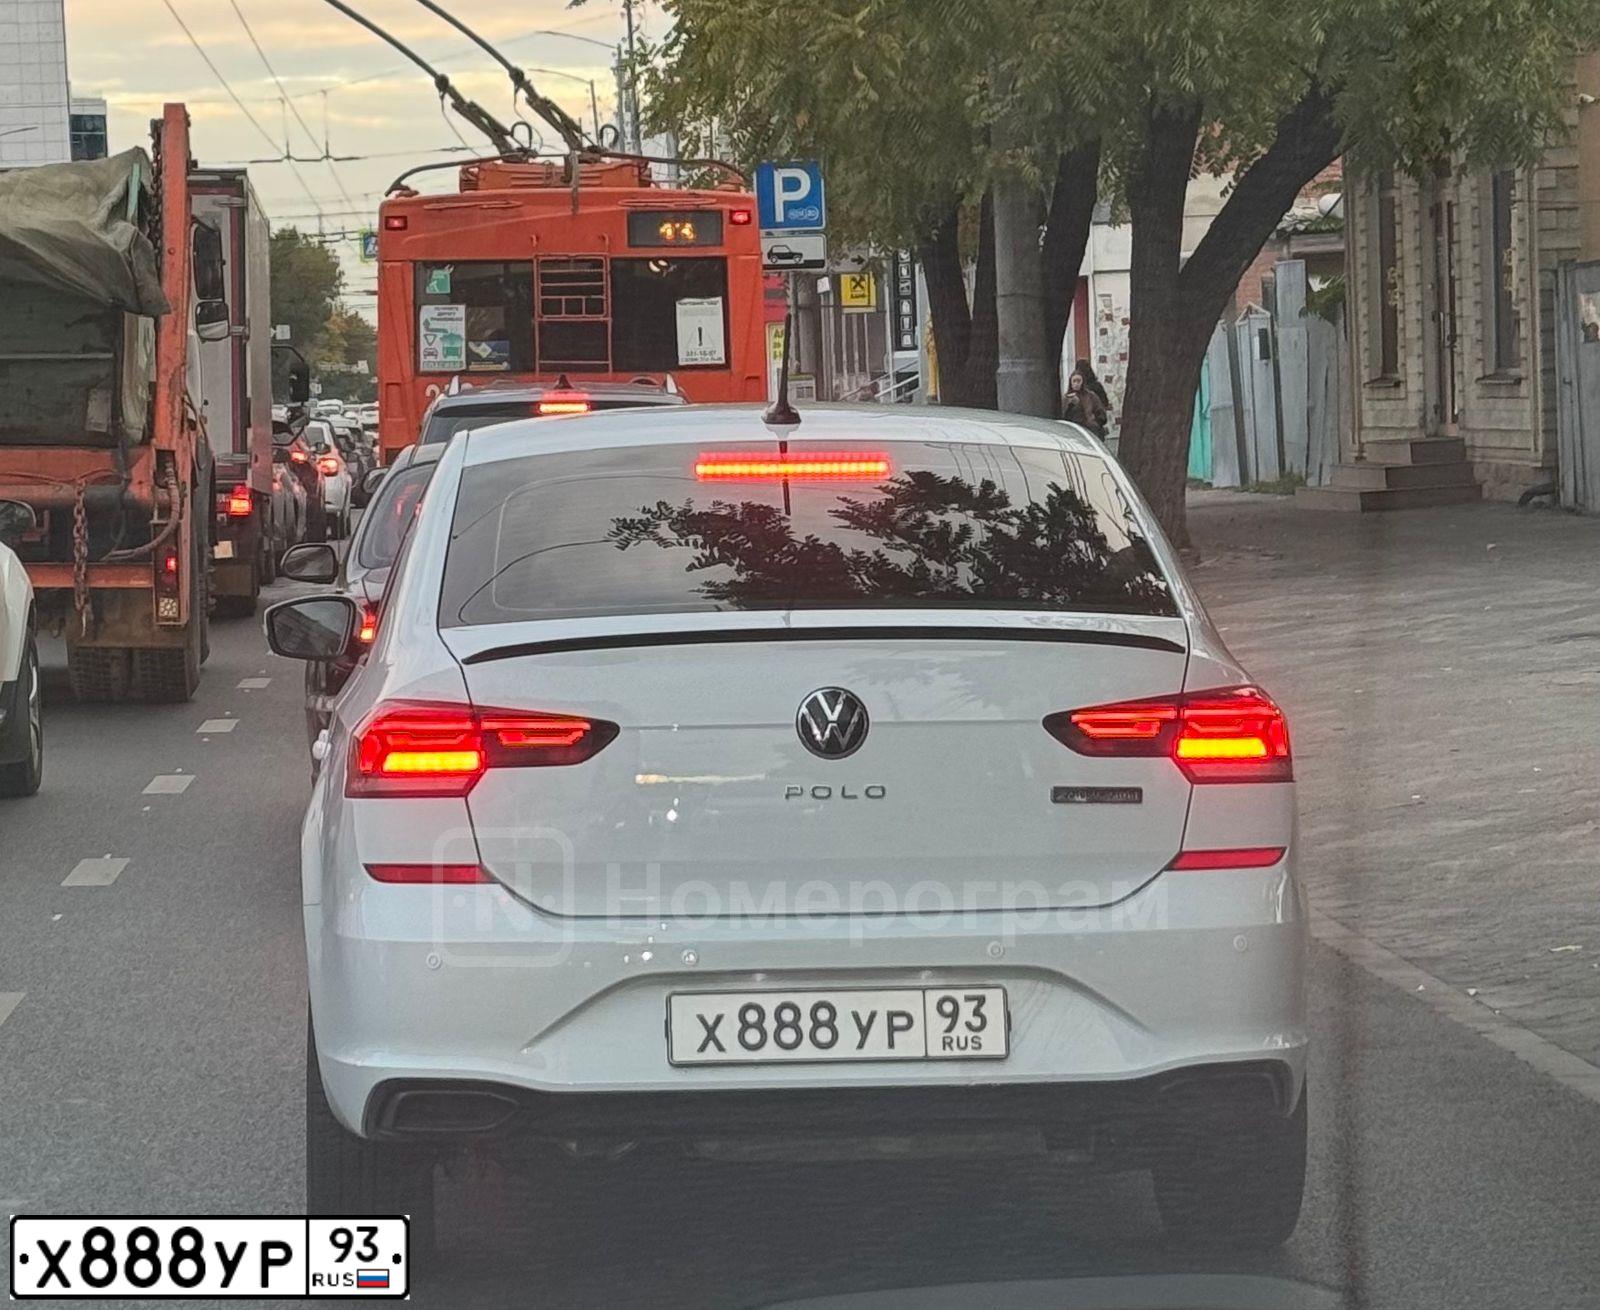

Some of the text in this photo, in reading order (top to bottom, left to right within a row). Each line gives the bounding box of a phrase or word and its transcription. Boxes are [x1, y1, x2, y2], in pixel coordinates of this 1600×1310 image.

[774, 167, 811, 223] P
[785, 785, 887, 800] POLO
[936, 994, 988, 1034] 93
[942, 1035, 983, 1052] RUS
